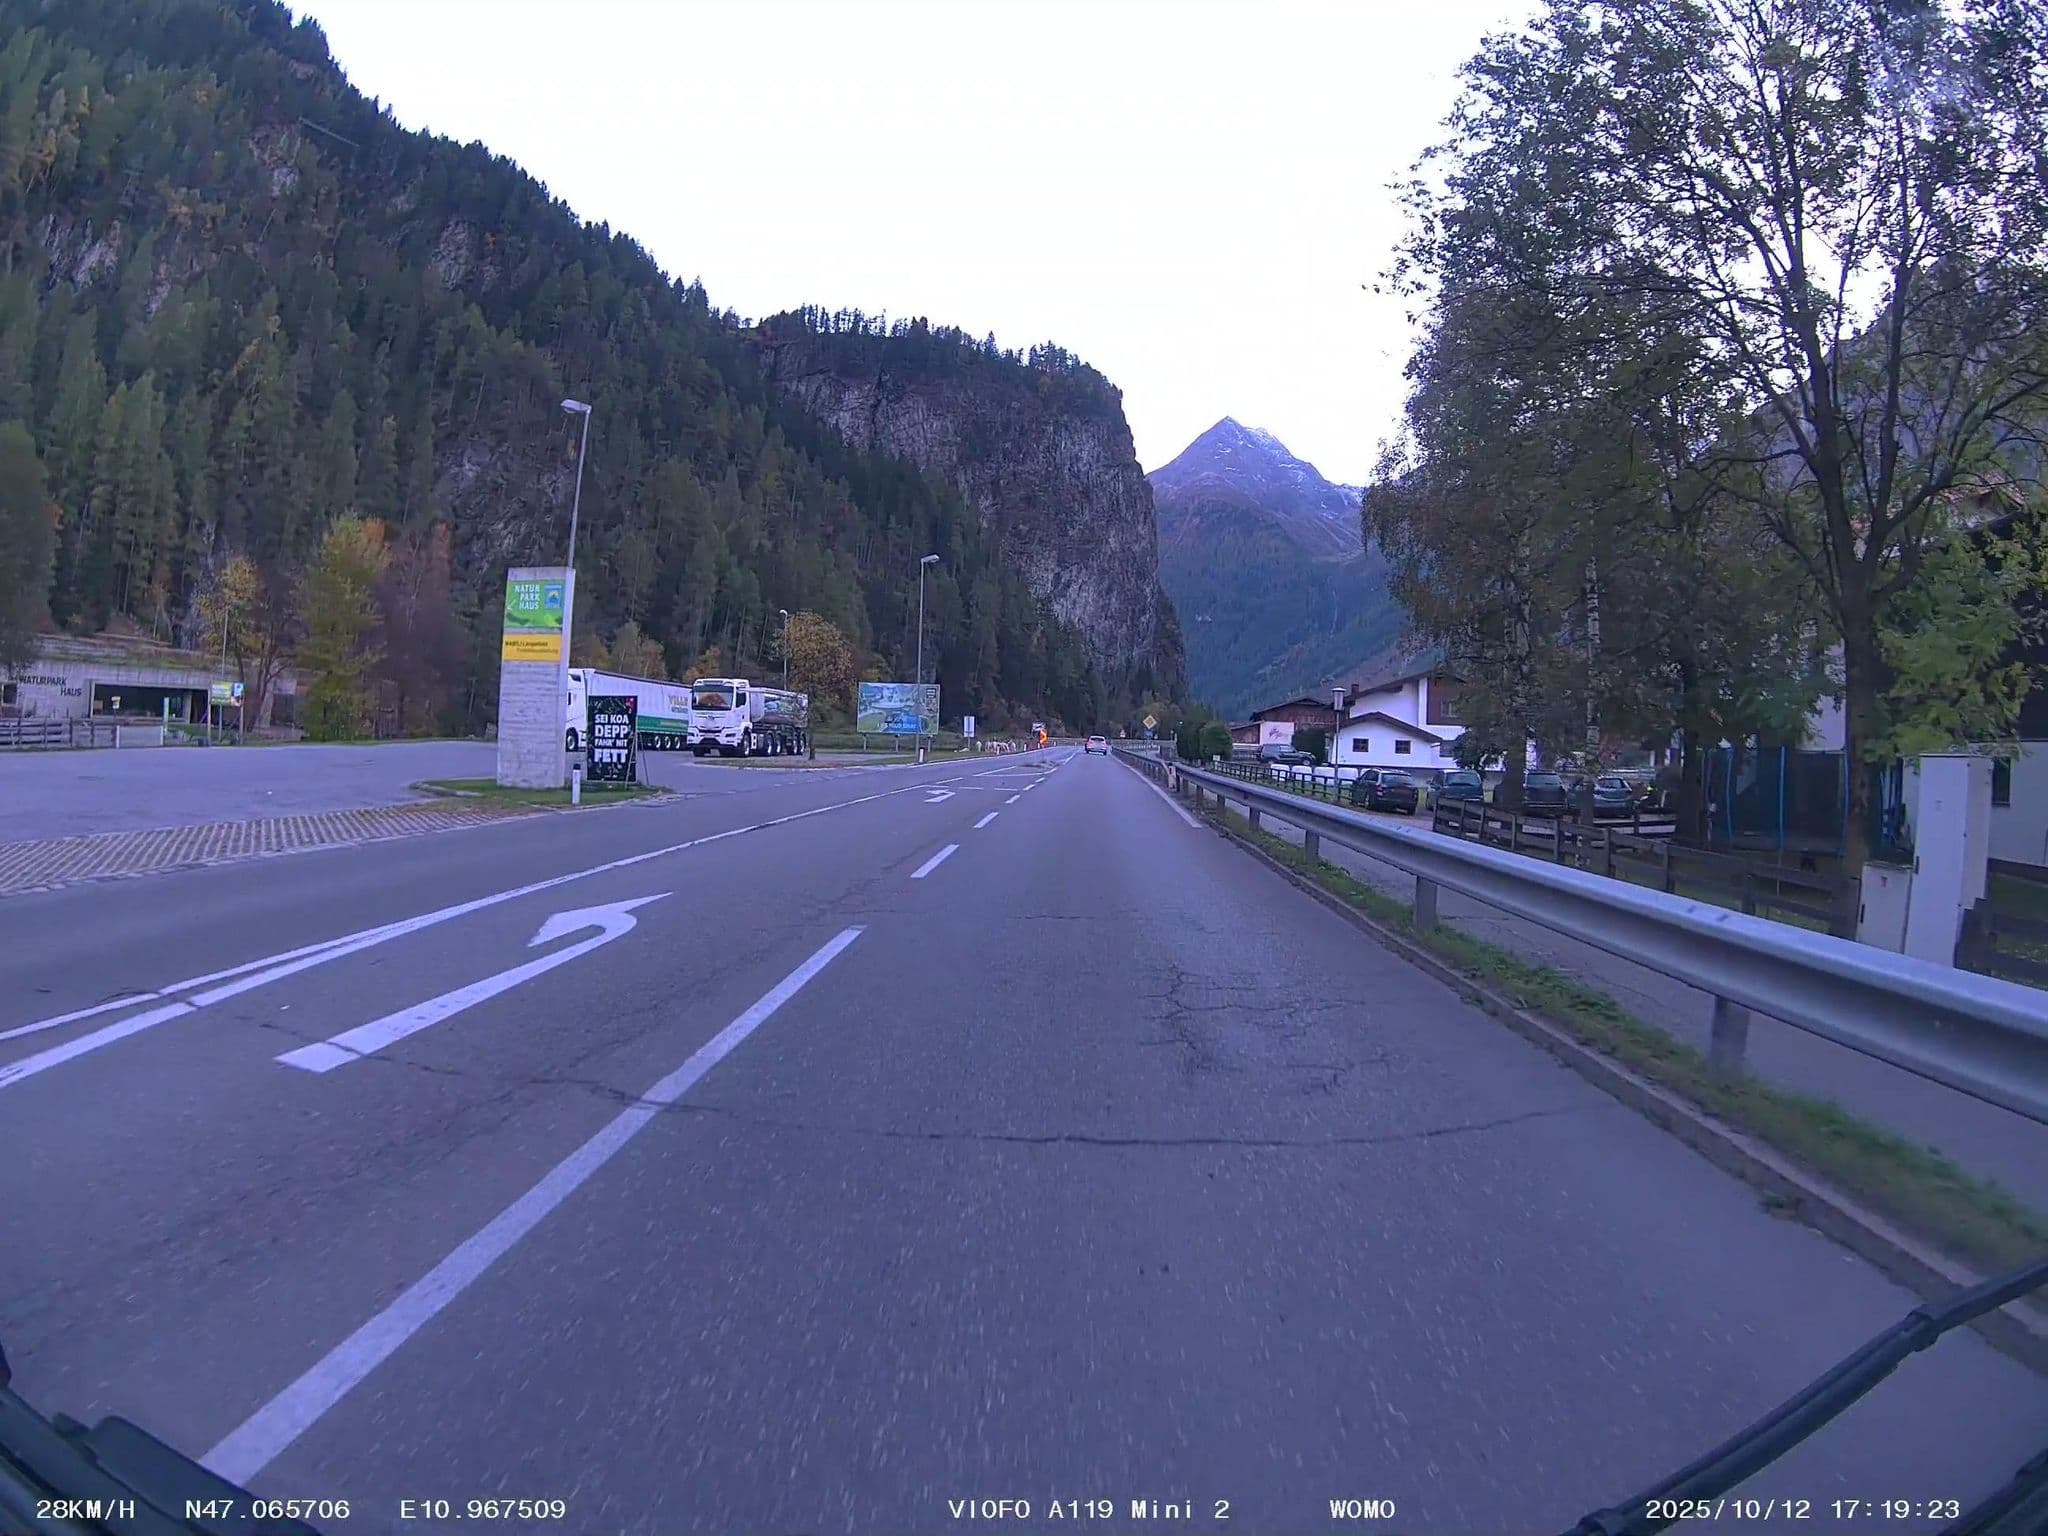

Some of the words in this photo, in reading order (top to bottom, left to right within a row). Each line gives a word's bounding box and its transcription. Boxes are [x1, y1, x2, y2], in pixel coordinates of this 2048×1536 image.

[514, 584, 540, 593] NATUR
[519, 593, 541, 601] PARK
[518, 602, 539, 610] HAUS
[19, 675, 67, 686] NATURPARK
[60, 687, 82, 697] HAUS
[594, 714, 608, 723] SEI
[610, 714, 629, 724] KOA
[594, 748, 628, 763] FETT
